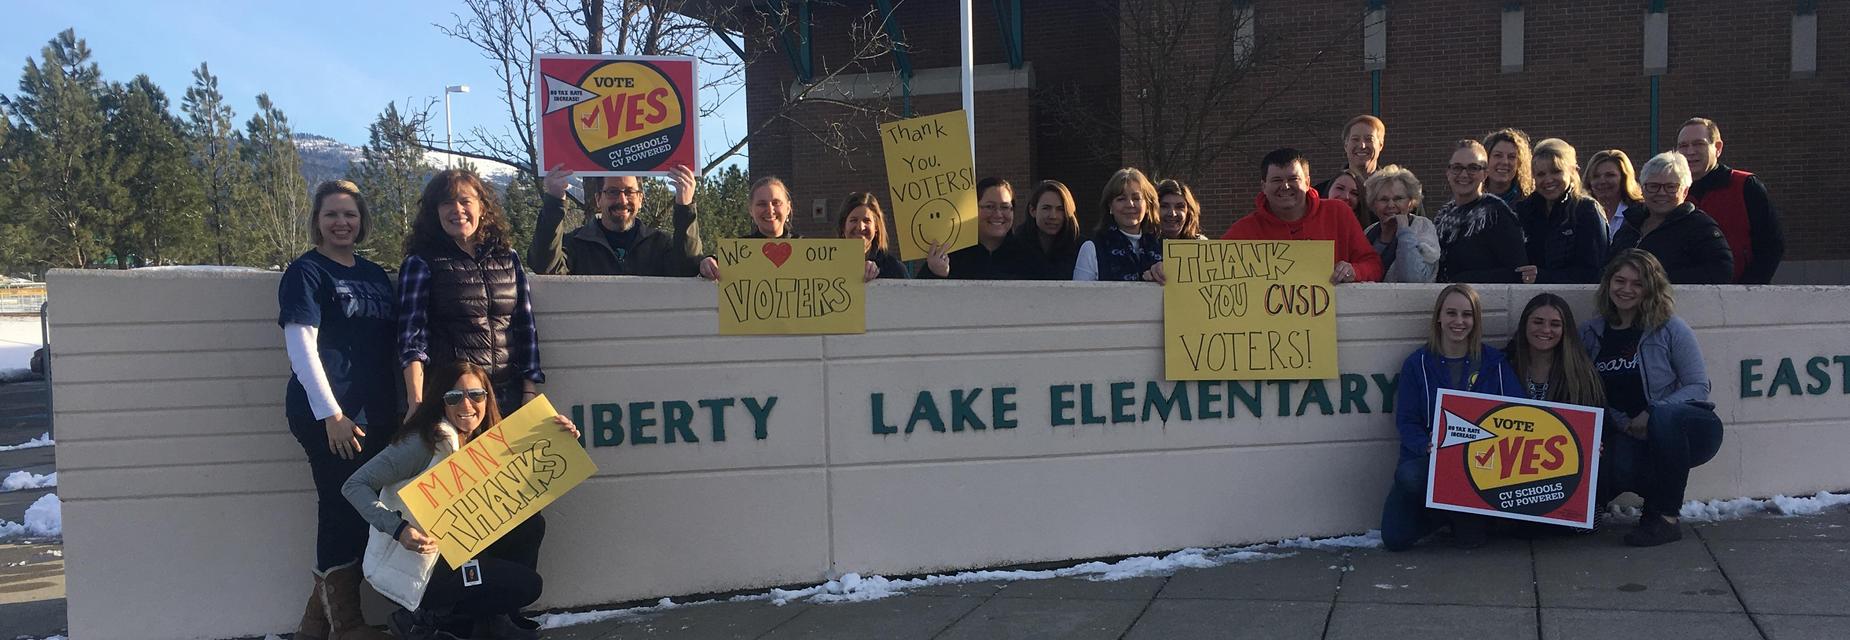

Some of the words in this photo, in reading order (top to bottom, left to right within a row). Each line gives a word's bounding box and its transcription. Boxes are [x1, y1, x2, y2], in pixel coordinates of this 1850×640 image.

[593, 77, 634, 88] VOTE
[602, 87, 668, 139] YES
[608, 149, 622, 161] CV
[624, 135, 669, 156] SCHOOLS
[887, 119, 948, 146] Thank
[611, 158, 625, 168] CV
[626, 144, 672, 164] POWERED
[892, 167, 976, 202] VOTERS!
[720, 241, 752, 267] We
[805, 245, 838, 262] our
[1168, 242, 1296, 284] THANK
[723, 277, 852, 323] VOTERS
[1198, 282, 1249, 319] YOU
[1264, 283, 1330, 318] CVSD
[1178, 329, 1313, 372] VOTERS!
[571, 396, 779, 448] IBERTY
[870, 387, 1018, 436] LAKE
[1049, 373, 1400, 427] ELEMENTARY
[1492, 417, 1535, 433] VOTE
[417, 426, 516, 509] MANY
[1498, 435, 1568, 480] YES
[429, 438, 568, 552] THANKS
[1499, 490, 1513, 501] CV
[1515, 482, 1563, 498] SCHOOLS
[1501, 499, 1515, 509] CV
[1516, 491, 1565, 507] POWERED
